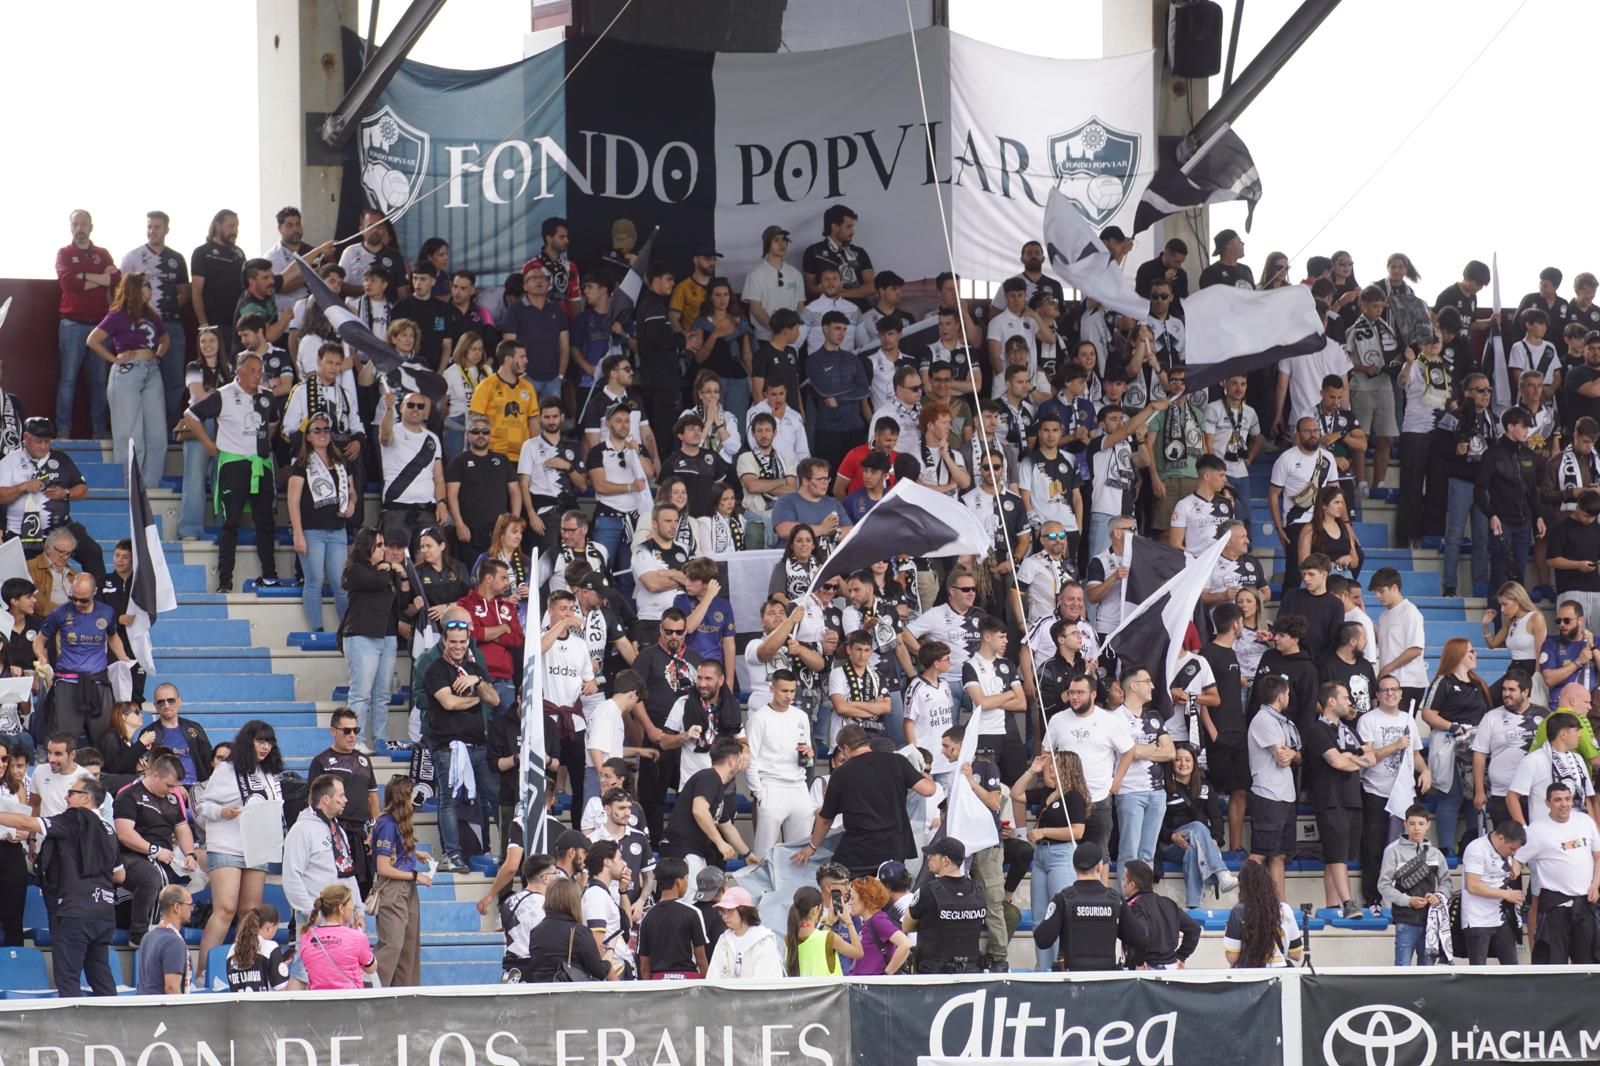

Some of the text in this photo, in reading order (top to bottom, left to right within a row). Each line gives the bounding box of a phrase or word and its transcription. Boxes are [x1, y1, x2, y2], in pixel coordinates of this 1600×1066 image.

[444, 120, 1047, 209] FONDO POPVLAR
[940, 908, 986, 920] SEGURIDAD
[1077, 906, 1112, 917] SEGURIDAD
[1451, 1030, 1572, 1060] HACHA
